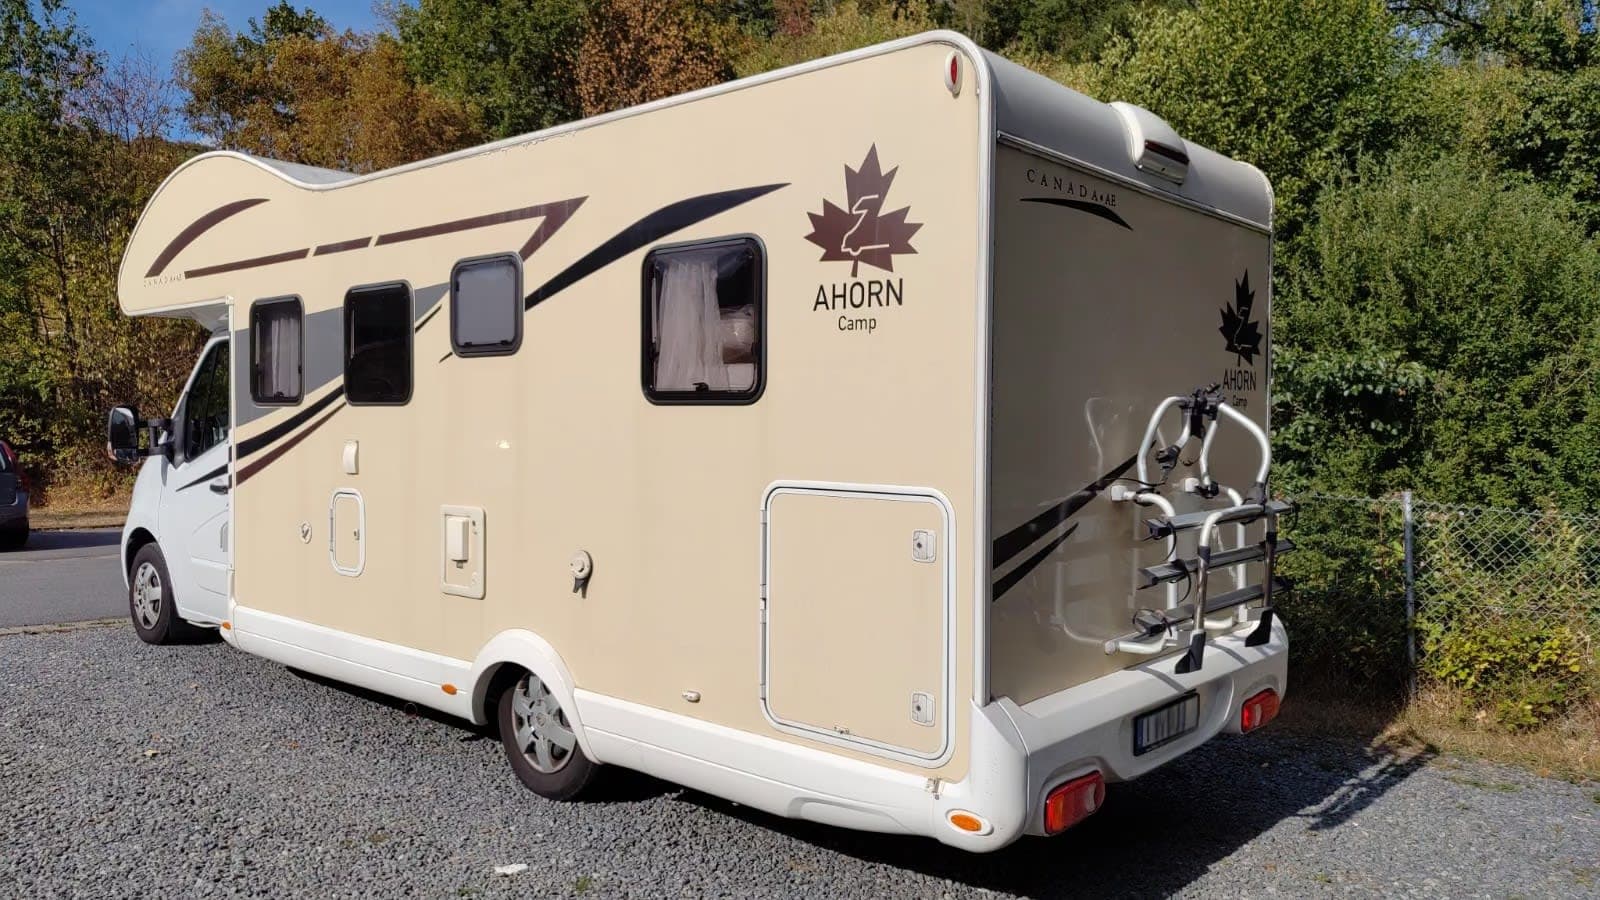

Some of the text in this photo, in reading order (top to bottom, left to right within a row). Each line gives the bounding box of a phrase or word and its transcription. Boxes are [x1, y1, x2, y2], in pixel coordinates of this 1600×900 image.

[813, 278, 903, 311] AHORN
[838, 315, 877, 334] Camp
[1222, 368, 1257, 391] AHORN
